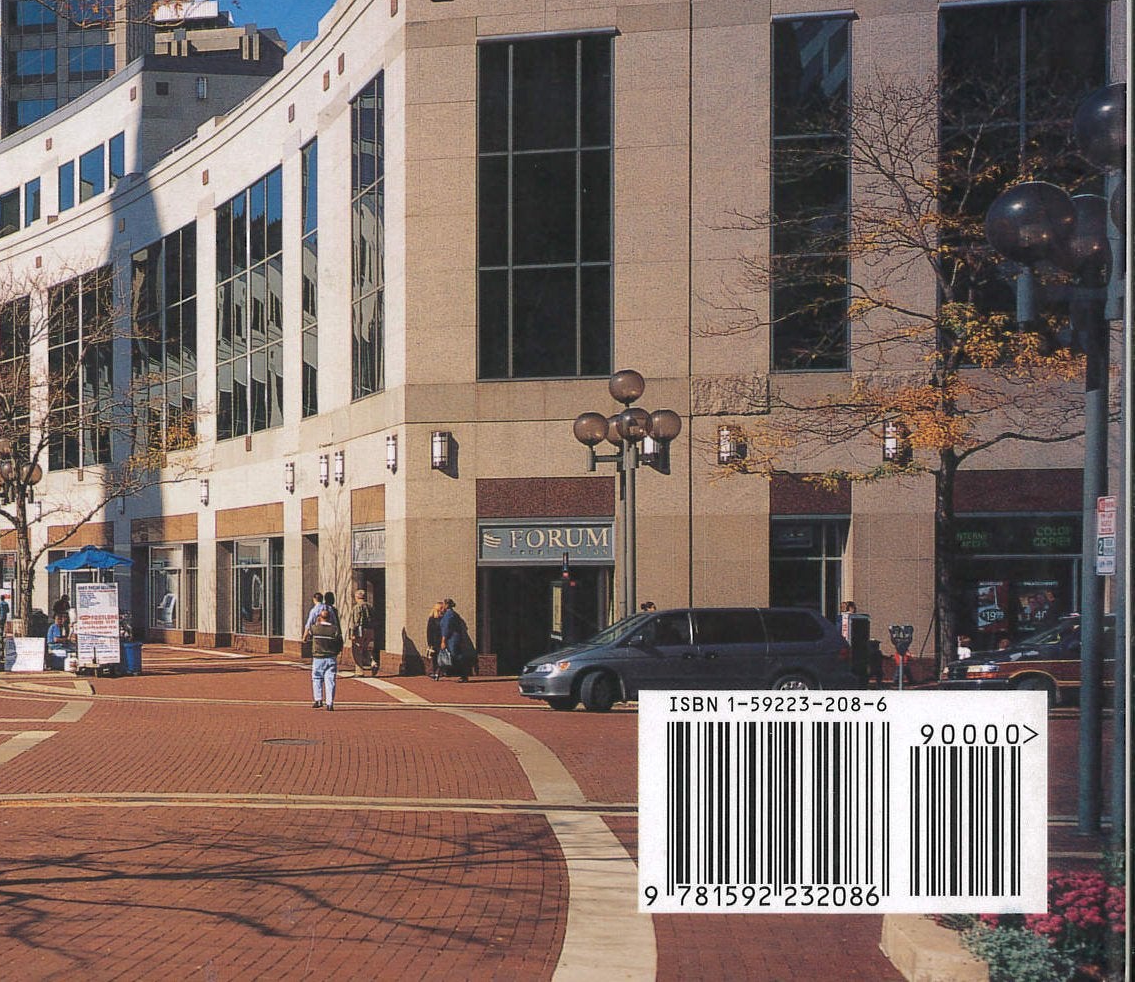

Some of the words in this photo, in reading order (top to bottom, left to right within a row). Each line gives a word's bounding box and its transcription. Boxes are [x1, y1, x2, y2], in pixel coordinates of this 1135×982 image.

[509, 527, 609, 549] FORUM
[669, 696, 718, 713] ISBN
[728, 696, 888, 713] 1-59223-208-6
[920, 723, 1040, 746] 90000>
